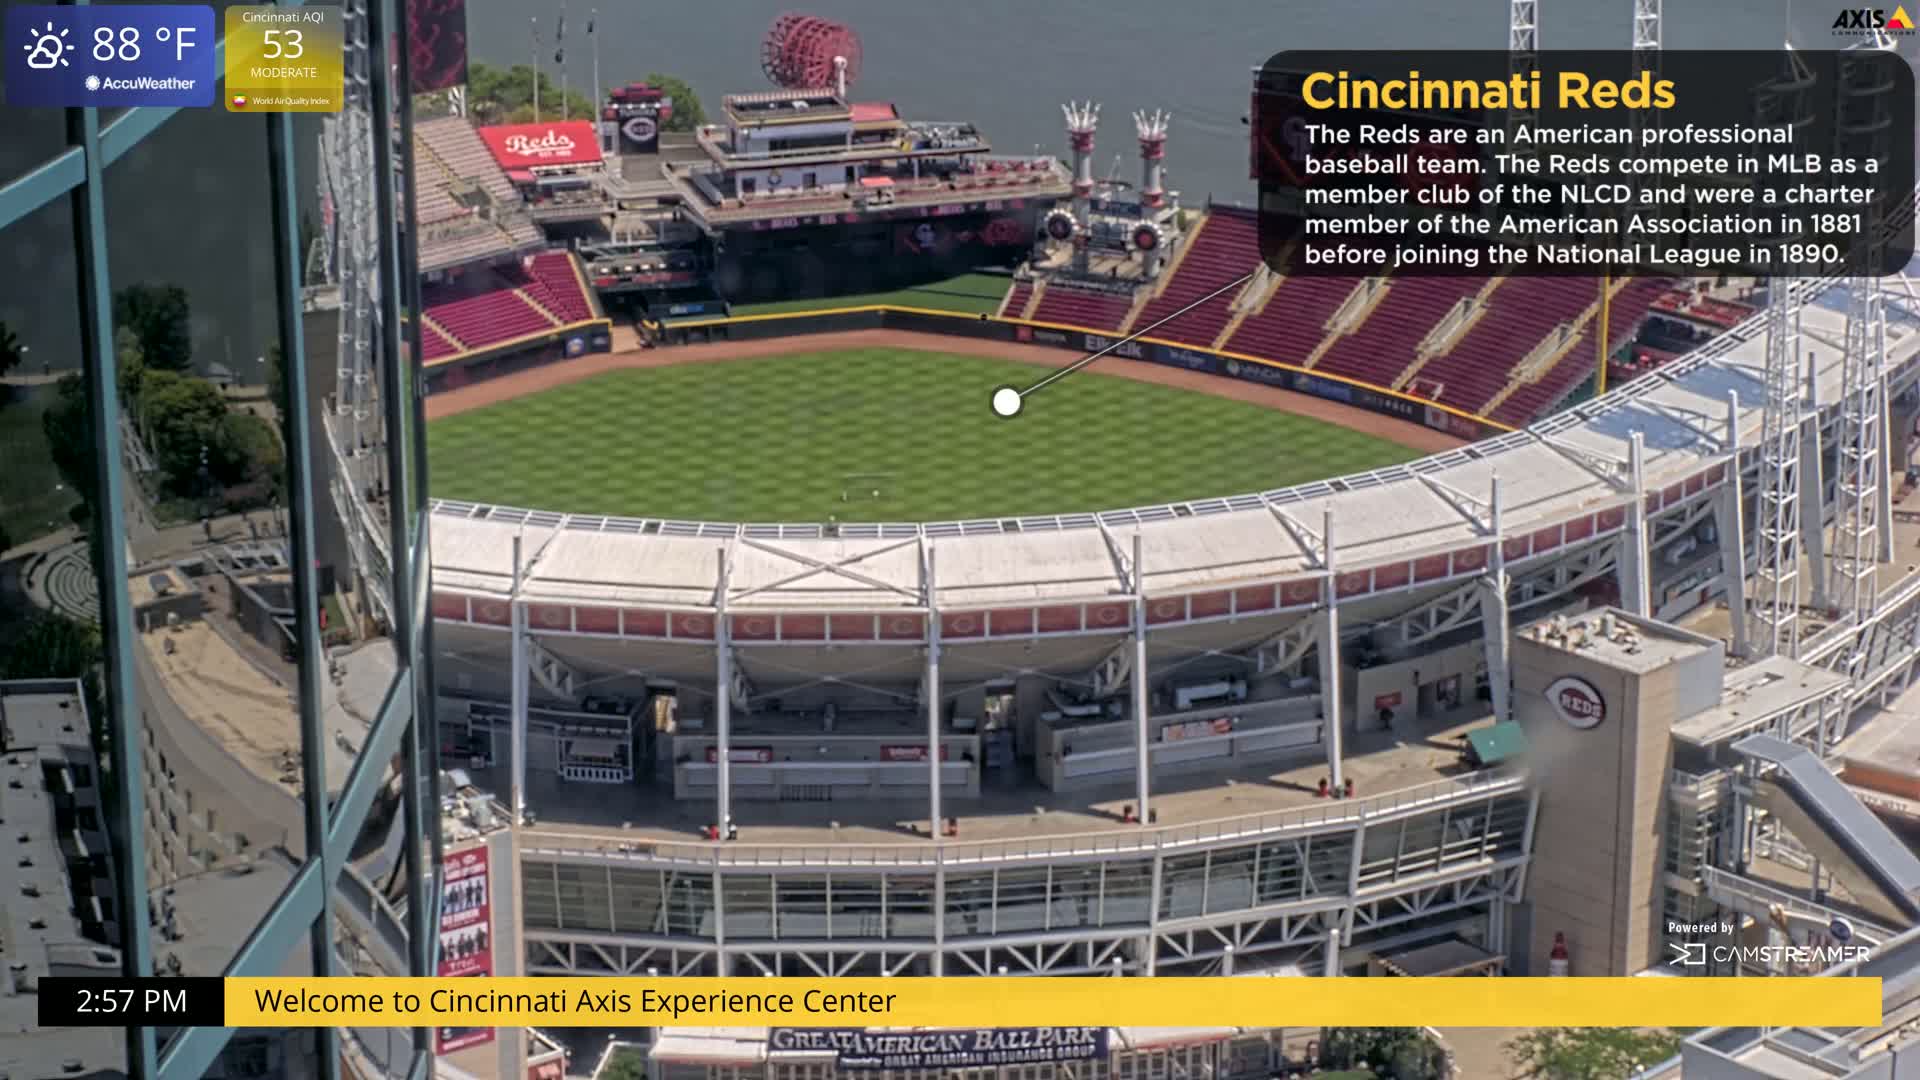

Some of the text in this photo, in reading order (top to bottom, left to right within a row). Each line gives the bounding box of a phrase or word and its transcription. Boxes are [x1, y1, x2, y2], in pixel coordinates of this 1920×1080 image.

[504, 129, 575, 155] Reds
[1561, 693, 1602, 718] REDS
[773, 1027, 1097, 1054] GREAT AMERICAN BALL PARK
